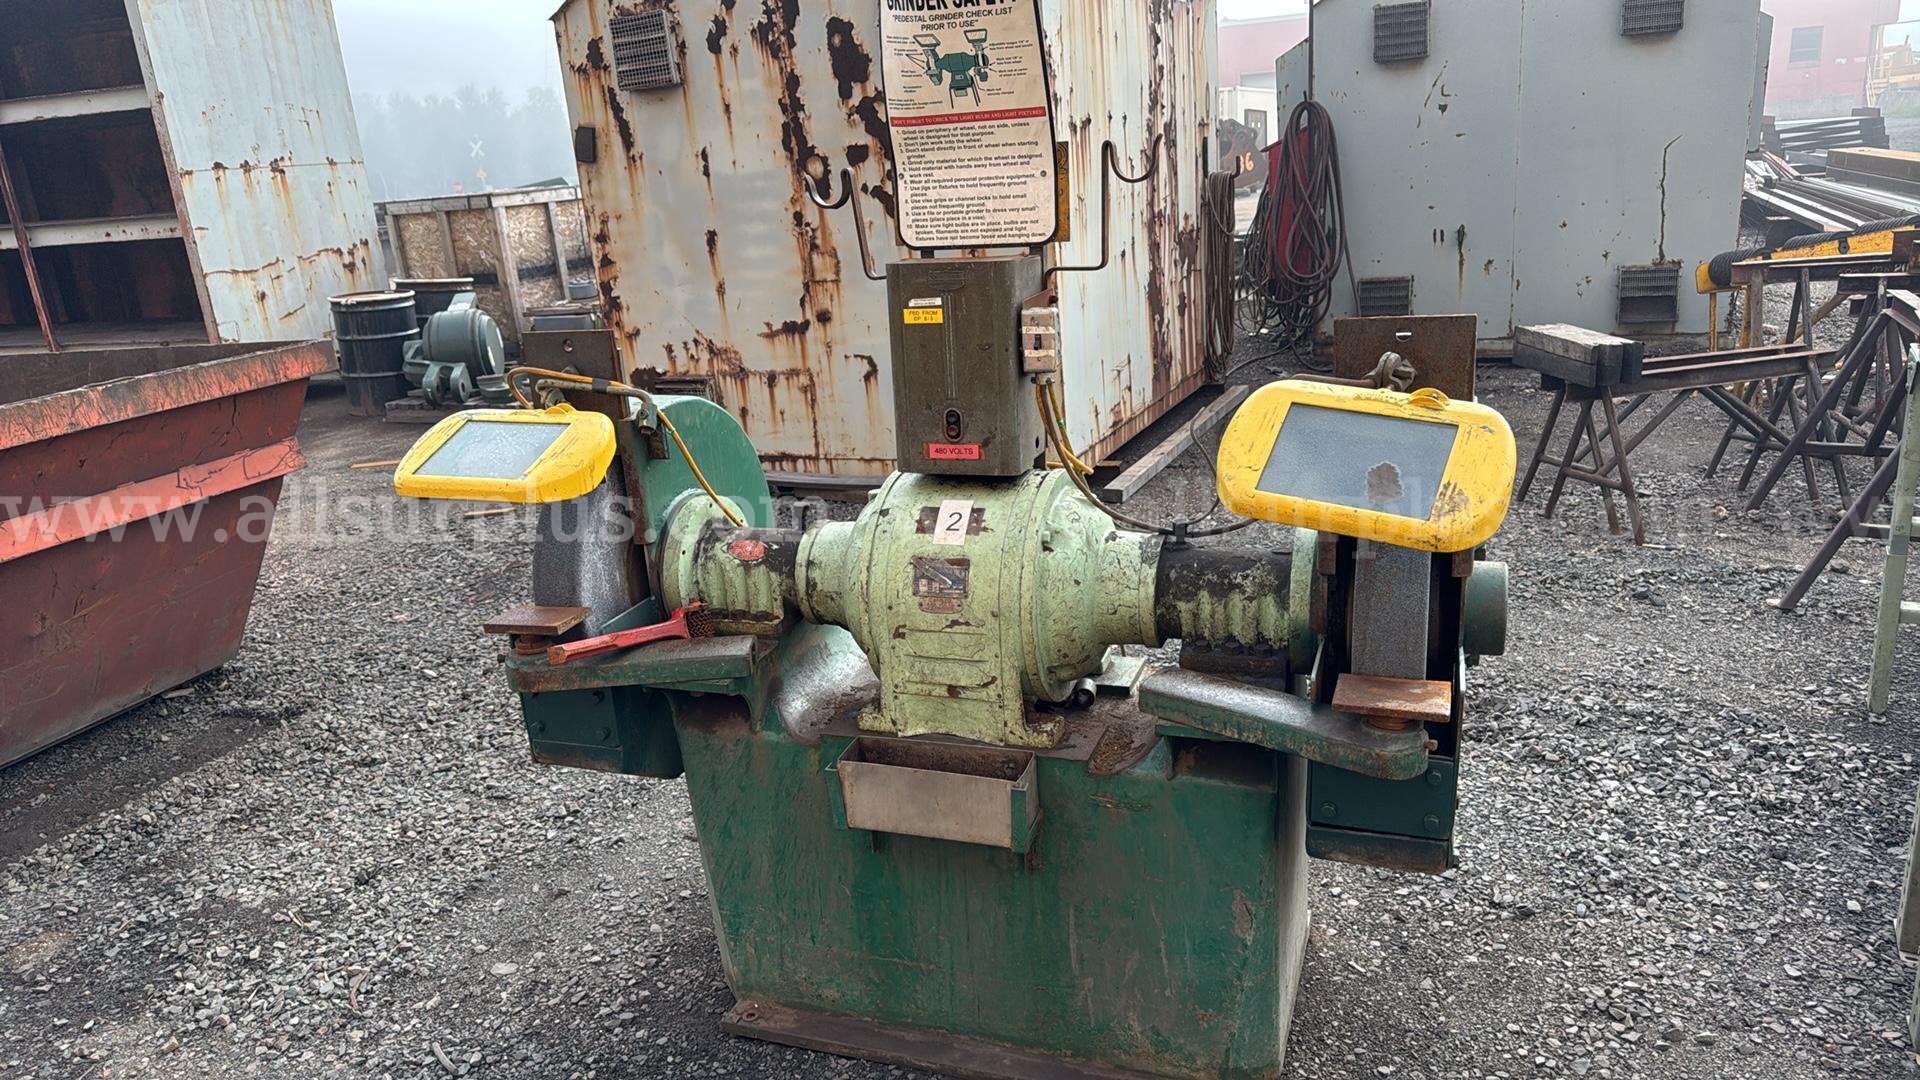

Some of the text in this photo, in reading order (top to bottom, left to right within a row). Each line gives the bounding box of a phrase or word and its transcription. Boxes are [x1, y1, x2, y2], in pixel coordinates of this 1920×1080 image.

[928, 11, 964, 22] GRINDER
[966, 9, 993, 18] CHECK
[995, 7, 1012, 16] LIST
[921, 23, 945, 31] PRIOR
[945, 512, 962, 531] 2
